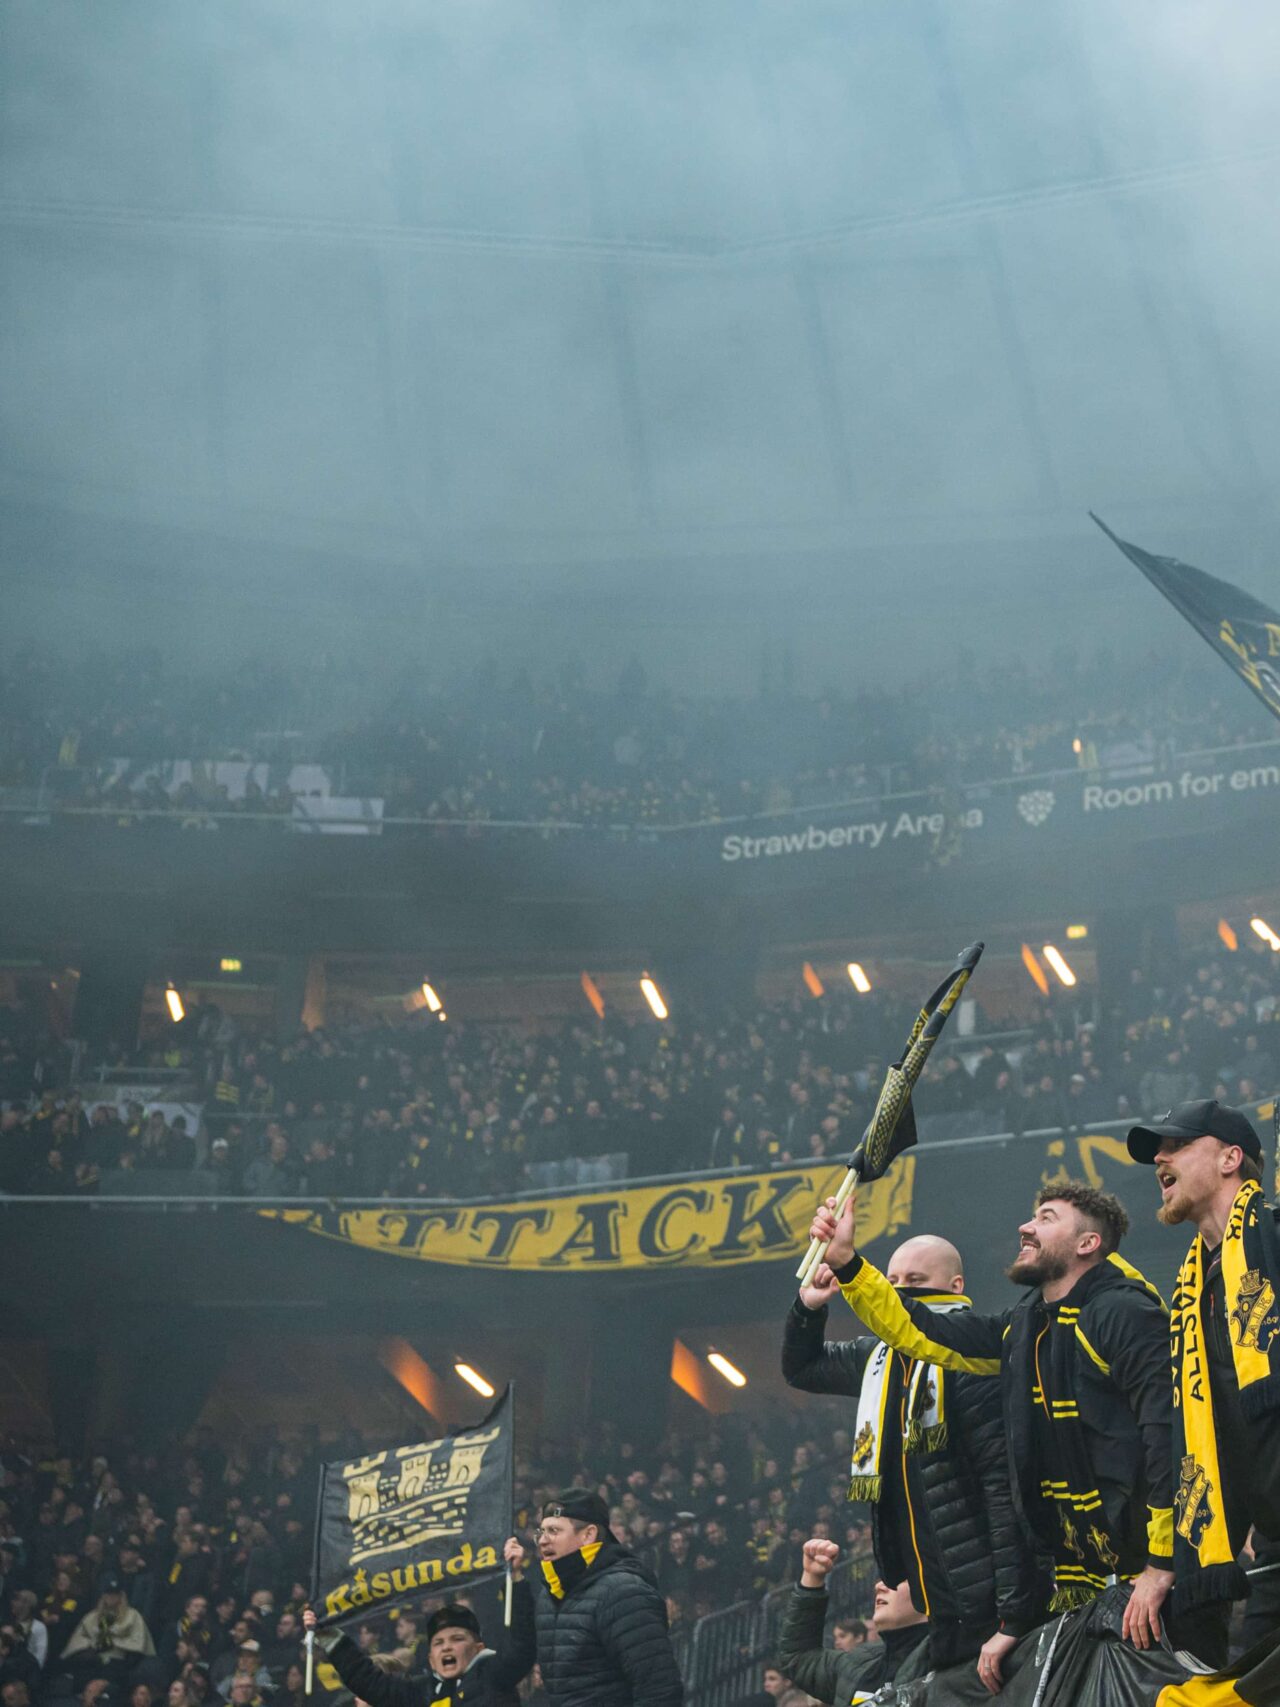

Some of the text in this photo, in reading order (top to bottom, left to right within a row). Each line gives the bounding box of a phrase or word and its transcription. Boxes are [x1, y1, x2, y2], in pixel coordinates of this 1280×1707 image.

[721, 821, 887, 861] Strawberry
[893, 808, 983, 838] Area
[1083, 780, 1173, 811] Room
[1180, 771, 1223, 798] for
[325, 1542, 497, 1617] Råsunda
